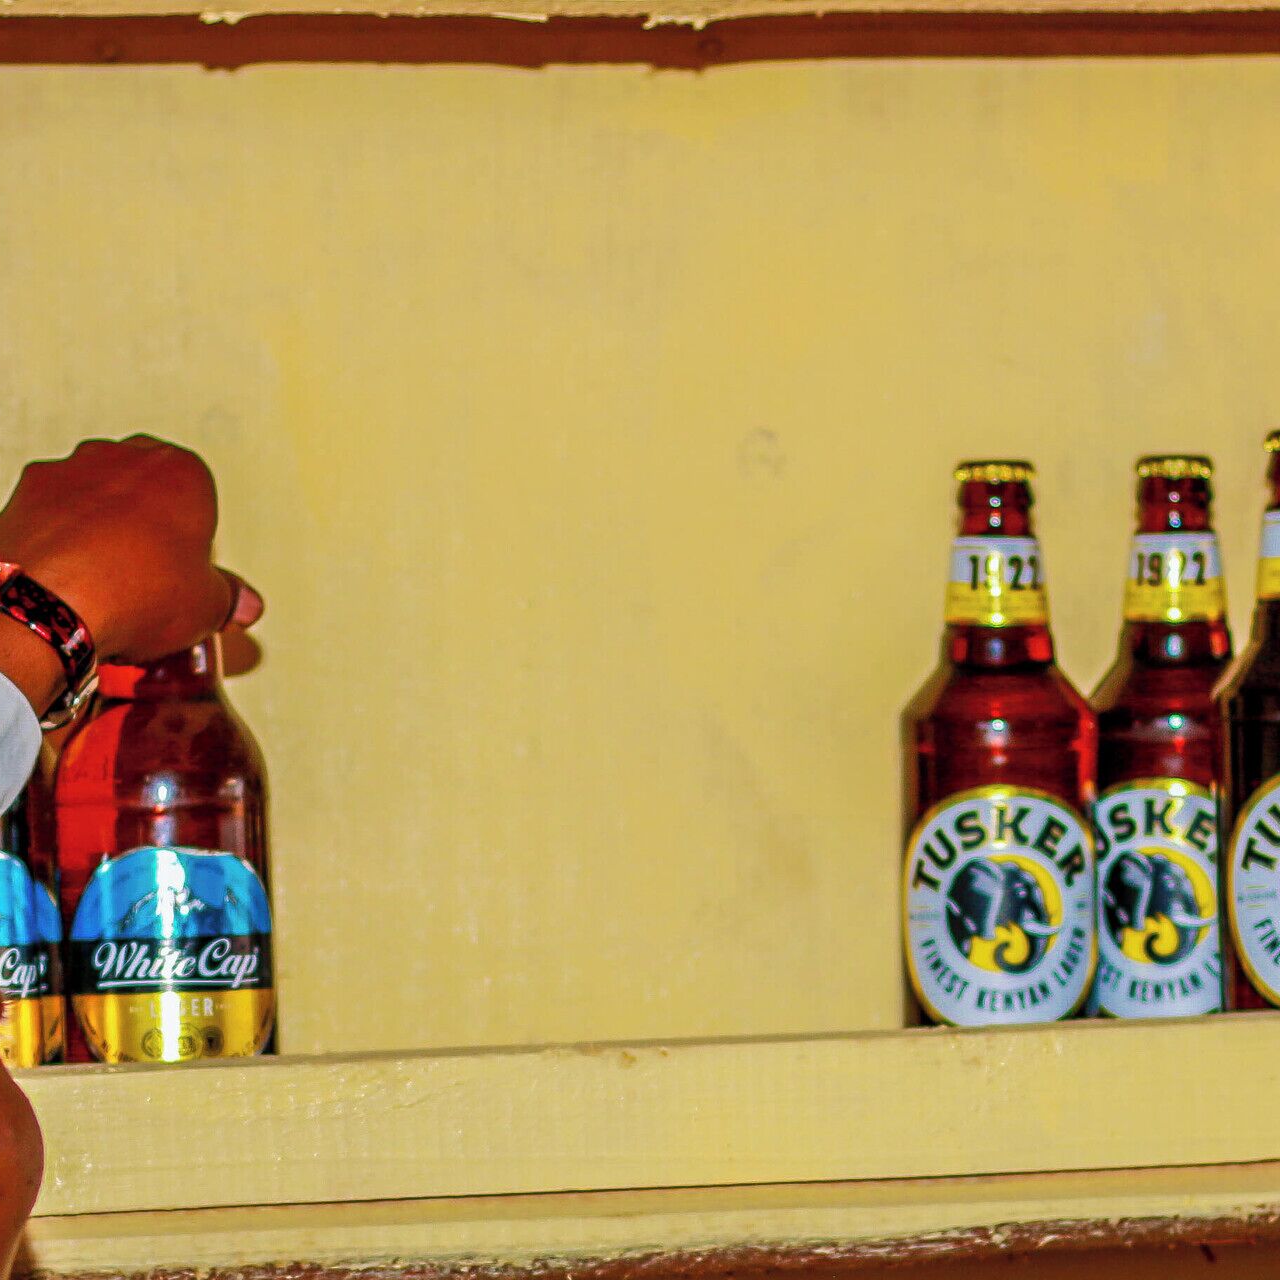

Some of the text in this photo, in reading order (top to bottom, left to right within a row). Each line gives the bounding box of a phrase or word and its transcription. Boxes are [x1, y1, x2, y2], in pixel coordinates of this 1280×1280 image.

[912, 806, 1085, 892] TUSKER
[94, 937, 259, 989] White Cap
